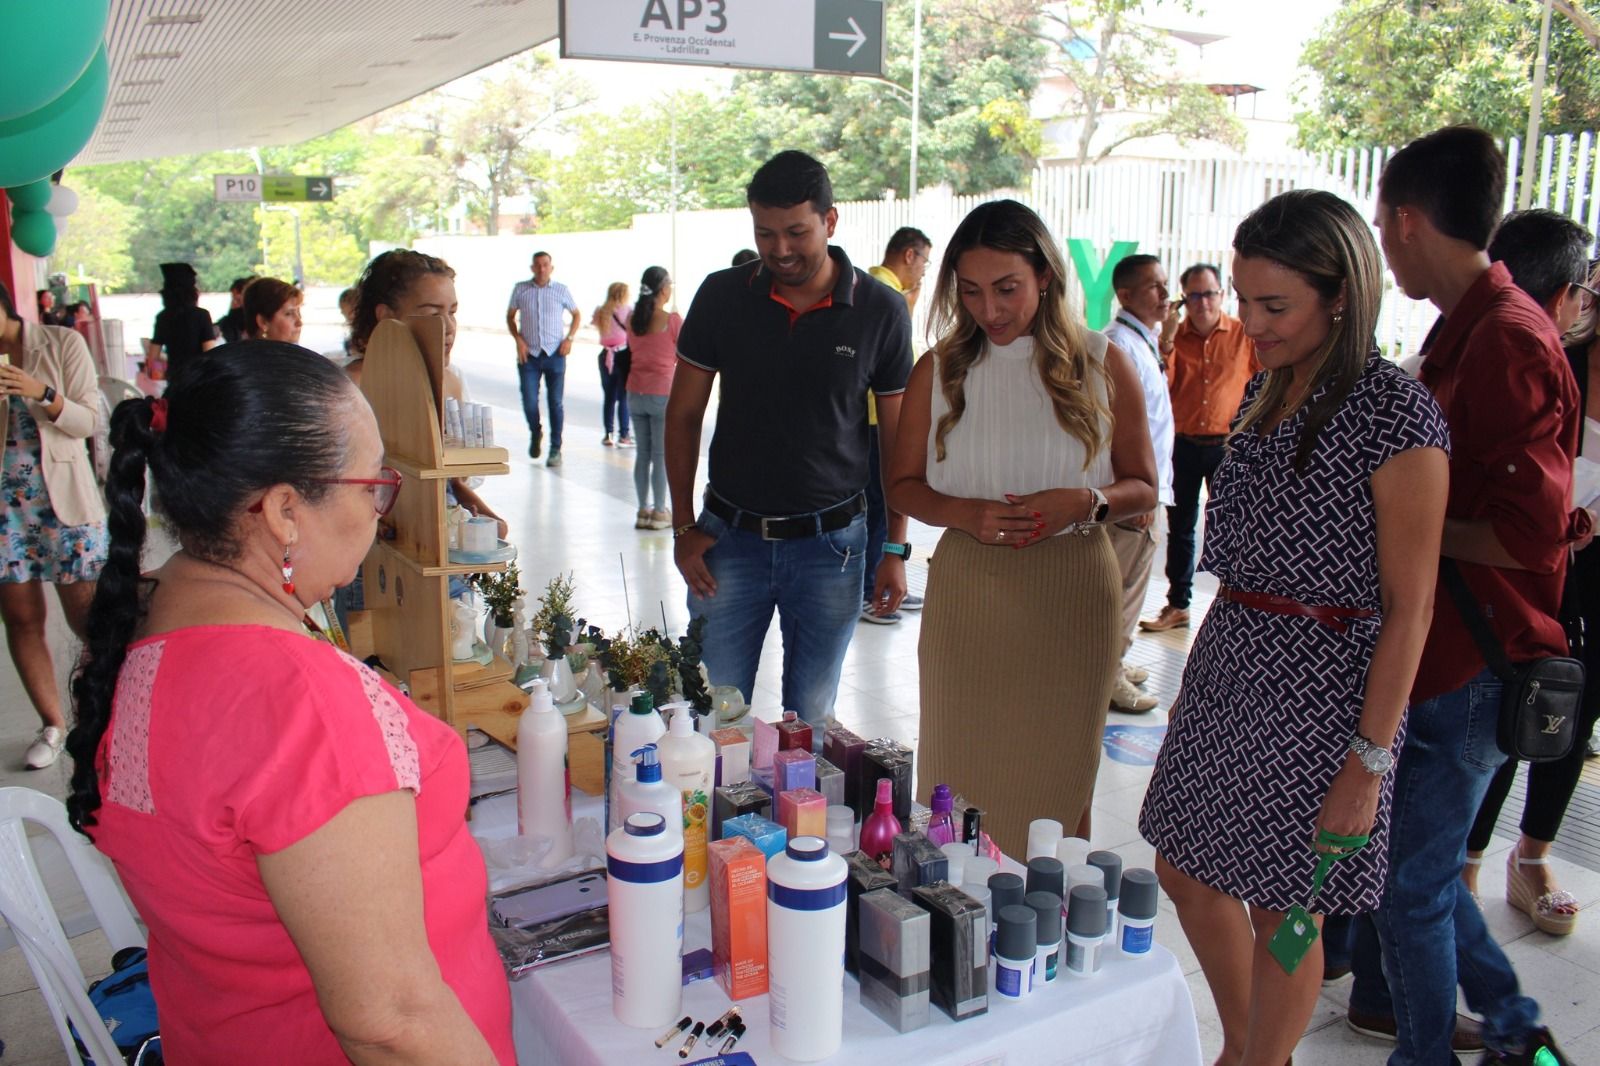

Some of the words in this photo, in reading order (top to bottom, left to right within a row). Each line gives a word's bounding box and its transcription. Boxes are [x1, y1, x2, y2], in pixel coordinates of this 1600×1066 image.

[640, 0, 728, 34] AP3
[644, 34, 686, 44] Provenza
[688, 36, 736, 48] Occidental
[226, 179, 256, 192] P10
[1066, 239, 1139, 331] Y
